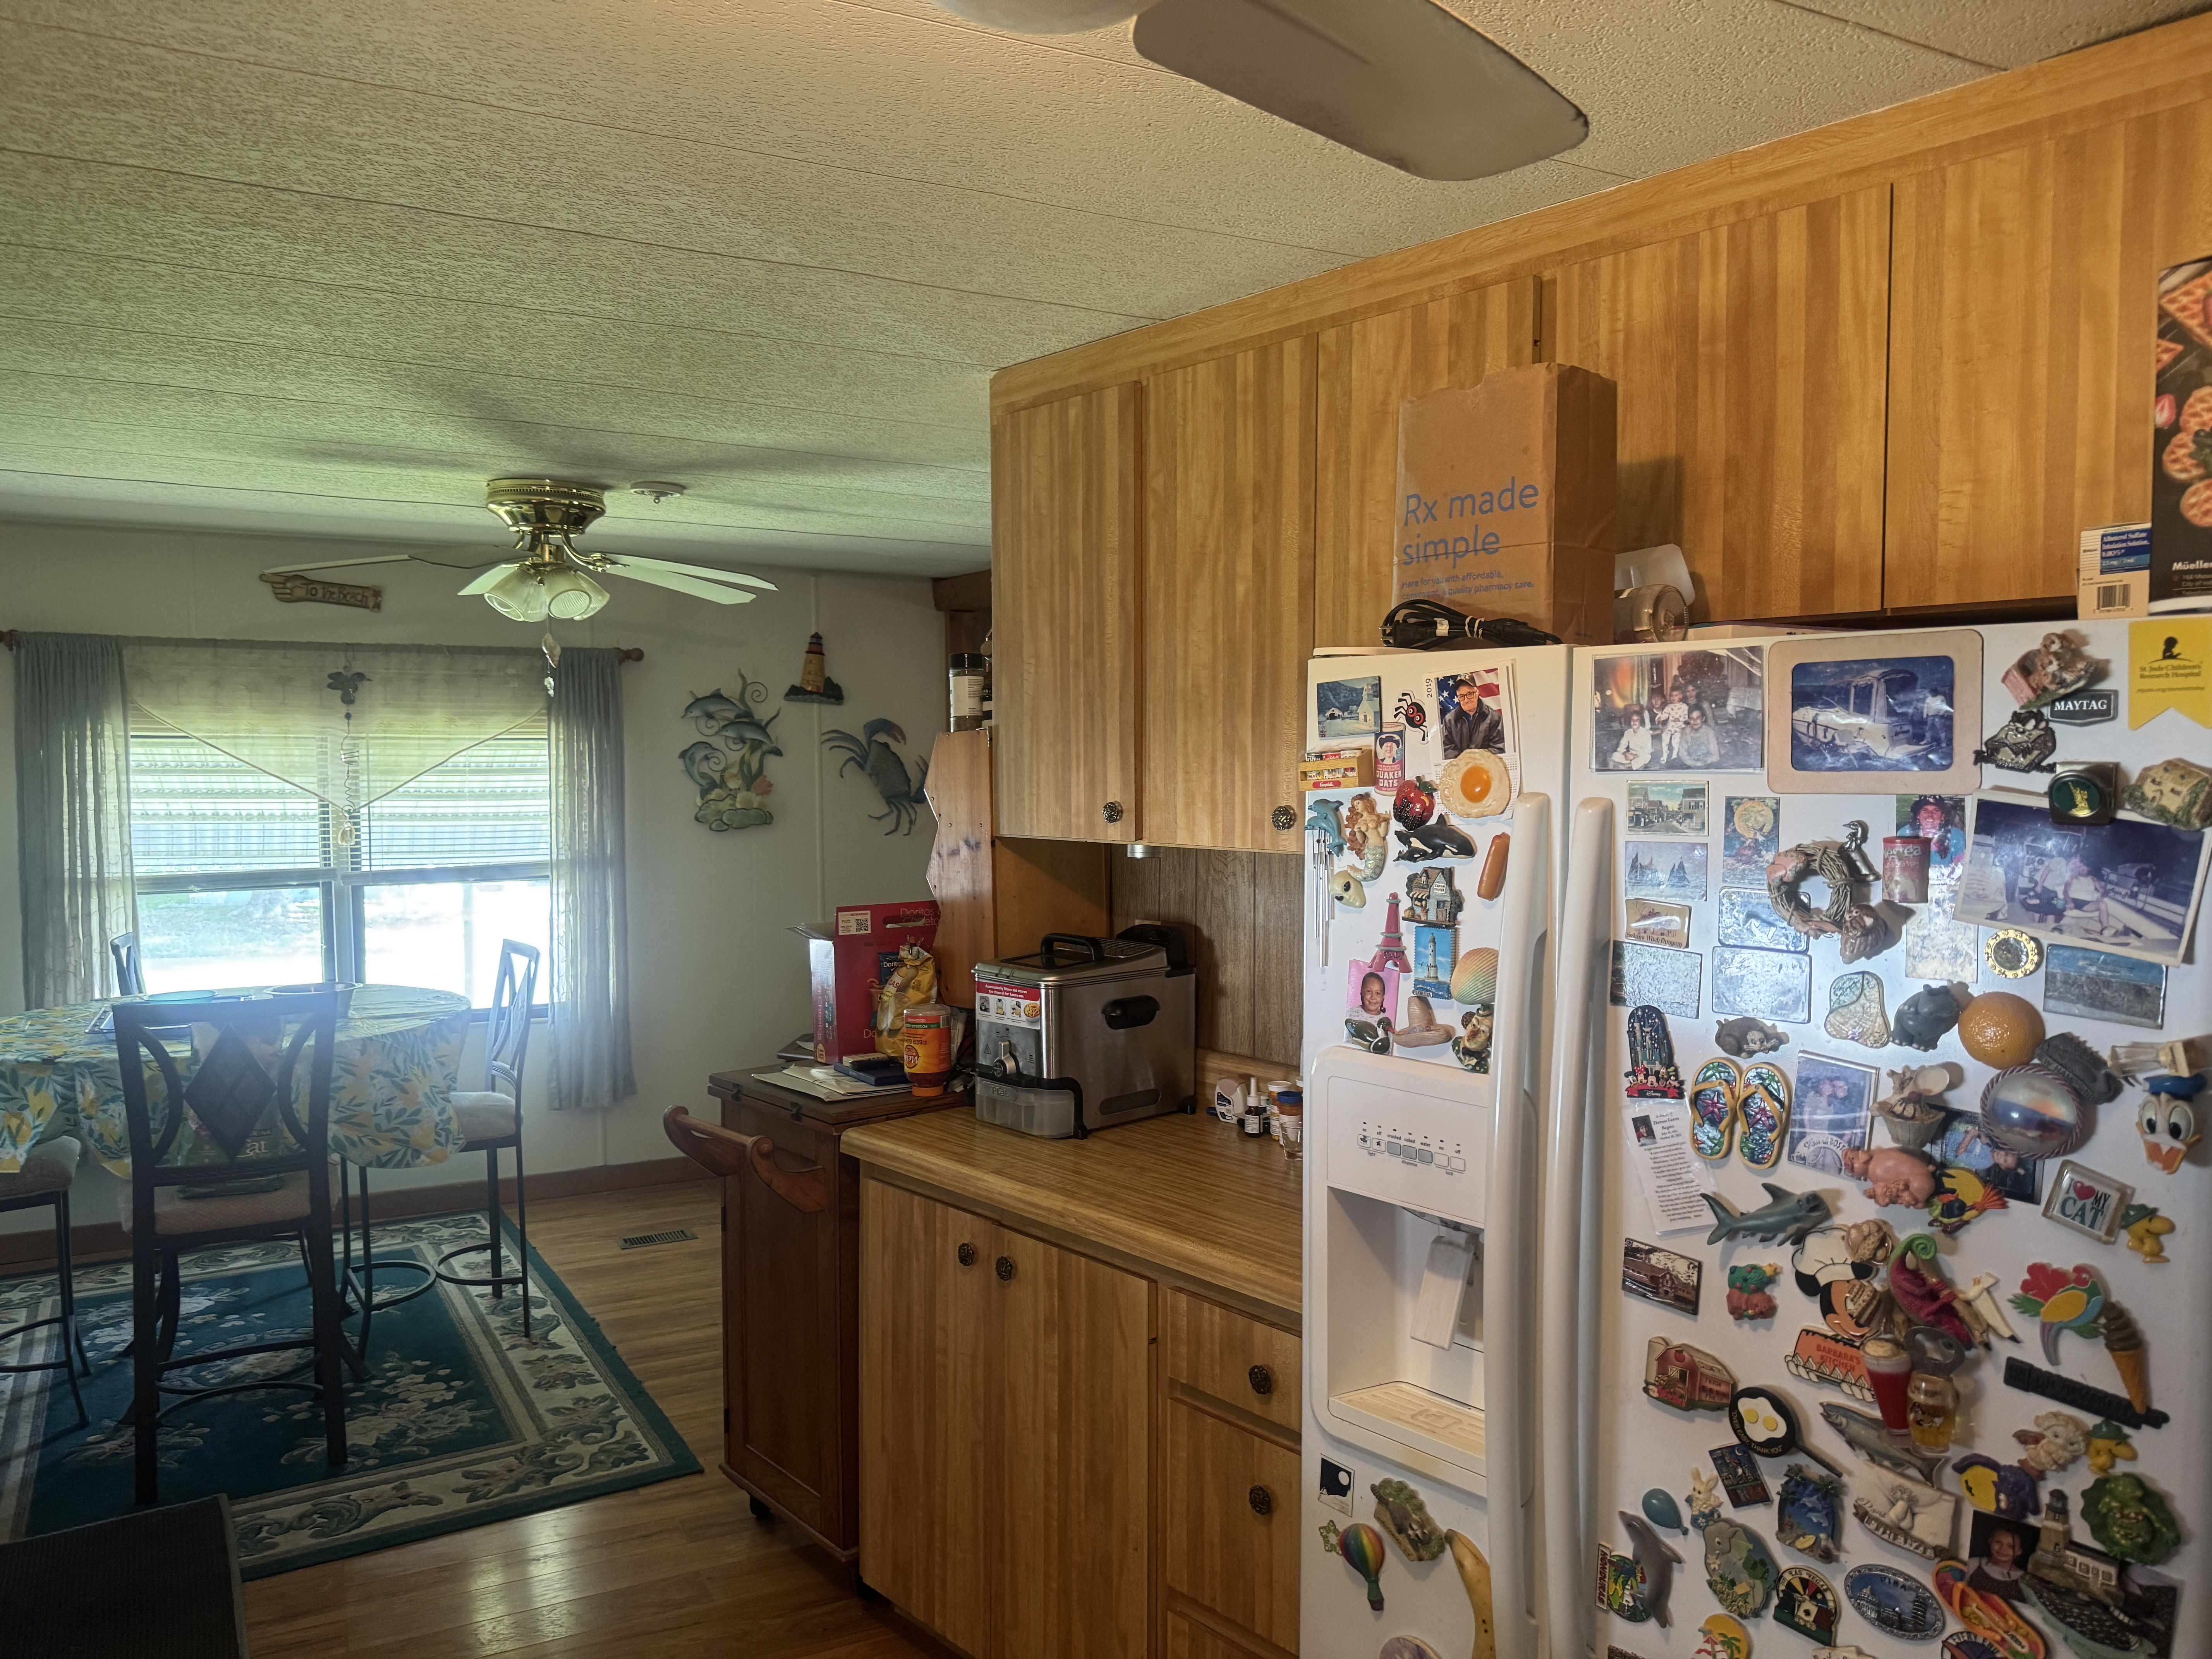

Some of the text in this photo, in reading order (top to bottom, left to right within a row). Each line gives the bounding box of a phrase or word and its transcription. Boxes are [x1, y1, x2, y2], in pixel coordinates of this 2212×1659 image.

[1404, 476, 1539, 527] Rx made
[1403, 524, 1500, 569] simple
[1432, 578, 1444, 587] you
[1445, 574, 1460, 583] with
[304, 582, 368, 606] To the Beach
[1448, 585, 1473, 595] quality
[1474, 582, 1513, 594] pharmacy
[2171, 671, 2201, 679] Hospital
[2054, 699, 2107, 711] MAYTAG
[1376, 770, 1402, 779] QUAKER
[1379, 779, 1398, 787] OATS
[900, 907, 934, 917] Doritos
[1647, 934, 1660, 943] Witch
[1413, 989, 1432, 998] FLORIDA
[1829, 1137, 1846, 1151] BOST
[2066, 1178, 2111, 1209] I MY
[2061, 1196, 2105, 1230] CAT
[1815, 1344, 1860, 1365] BARBARA'S
[1820, 1355, 1856, 1372] KITCHEN
[1597, 1550, 1607, 1604] HONDURAS
[1806, 1572, 1830, 1593] VEGAS
[1881, 1576, 1907, 1591] PISA
